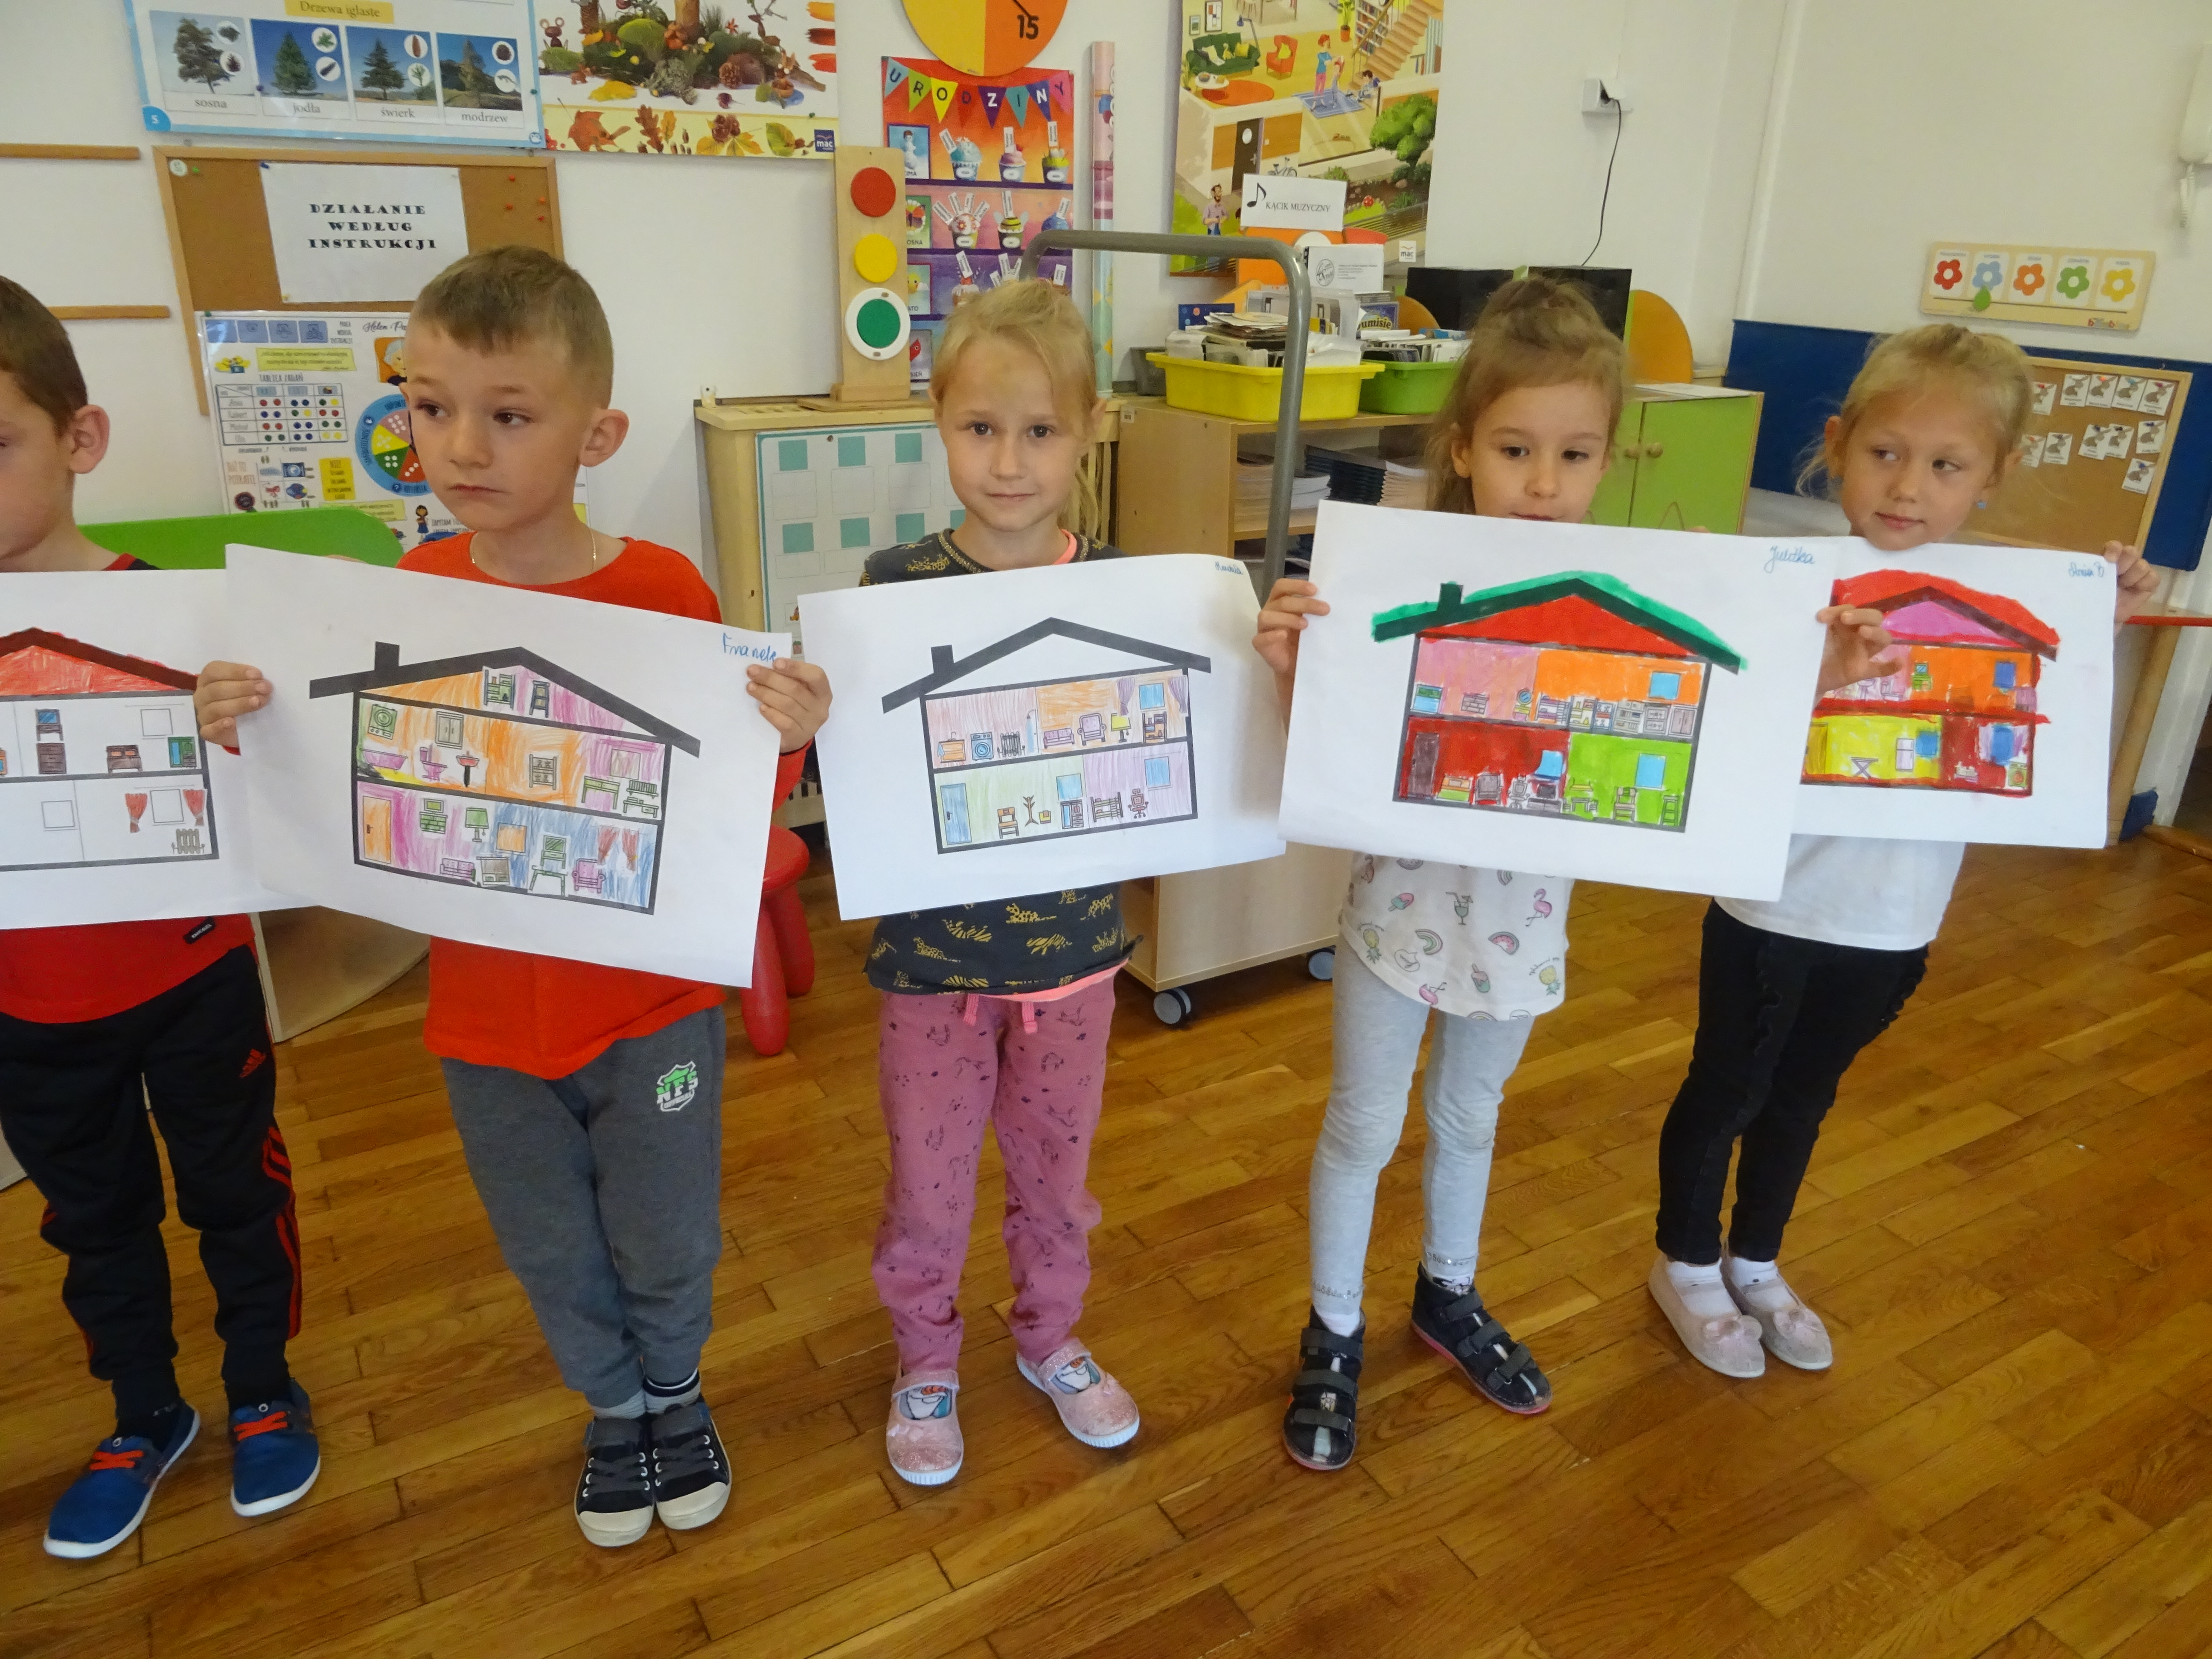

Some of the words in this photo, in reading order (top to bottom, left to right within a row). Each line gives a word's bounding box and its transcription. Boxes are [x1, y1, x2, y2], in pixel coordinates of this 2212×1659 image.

[299, 1, 343, 14] Drzewa
[346, 5, 380, 18] iglaste
[1017, 15, 1039, 39] 15
[195, 99, 227, 108] sosna
[292, 102, 321, 115] jodła
[381, 107, 415, 118] świerk
[461, 112, 508, 123] modrzew
[151, 115, 159, 123] 5
[310, 203, 426, 215] DZIAŁANIE
[1266, 201, 1288, 211] KĄCIK
[1290, 203, 1331, 212] MUZYCZNY
[328, 221, 413, 232] WEDŁUG
[307, 238, 437, 250] INSTRUKCJI
[363, 321, 388, 332] Helen
